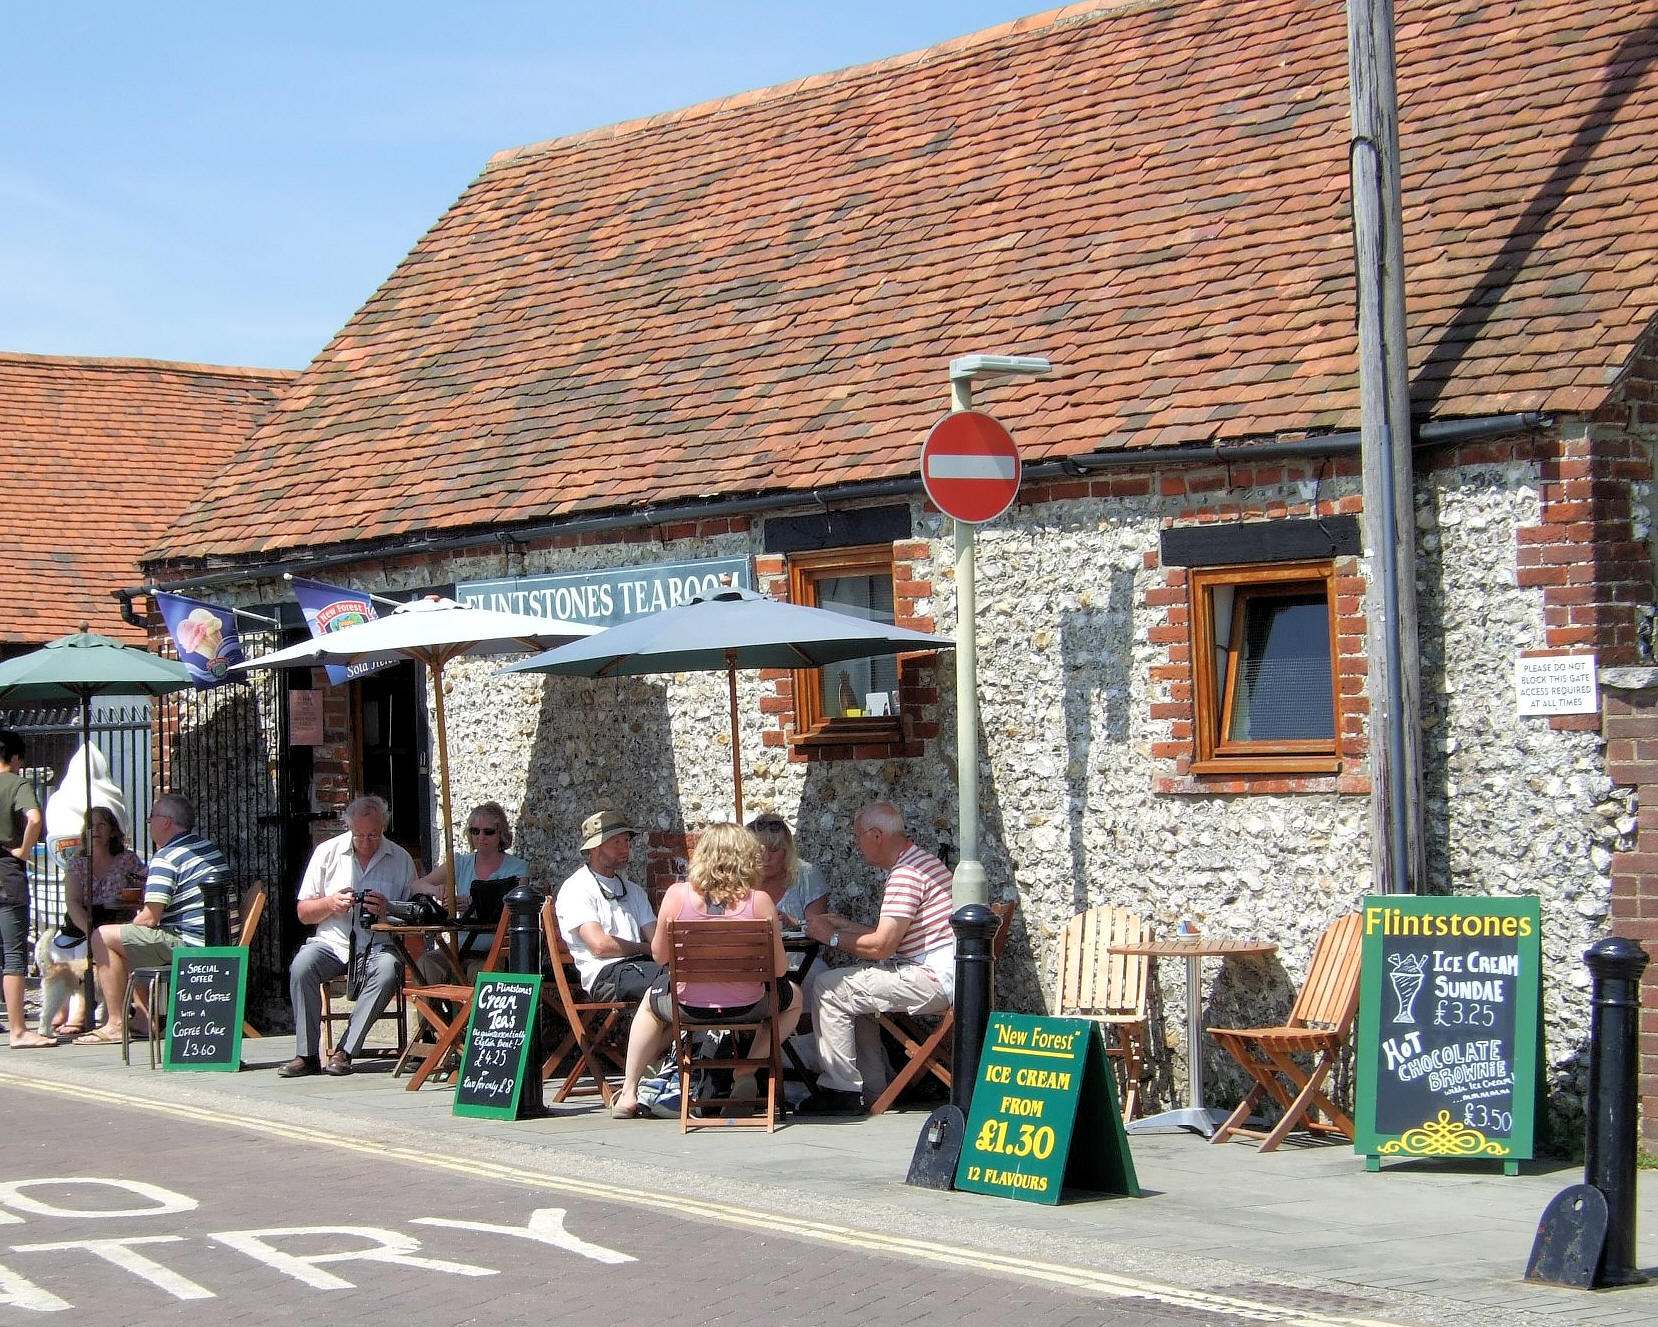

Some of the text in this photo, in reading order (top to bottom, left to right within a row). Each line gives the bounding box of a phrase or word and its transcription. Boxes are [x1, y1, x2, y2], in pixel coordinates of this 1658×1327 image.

[1523, 662, 1586, 673] PLEASE DO NOT
[1521, 674, 1590, 684] BLOCK THIS GATE
[1520, 686, 1592, 696] ACCESS REQUIRED
[1542, 699, 1557, 707] ALL
[1559, 698, 1583, 707] TIMES
[1365, 907, 1533, 937] Flintstones
[187, 963, 220, 974] SPECIAL
[1432, 950, 1519, 977] ICE CREAM
[190, 975, 214, 983] OFFER
[496, 982, 533, 996] Flintstones
[1434, 975, 1505, 1003] SUNDAE
[177, 988, 193, 1002] TEA
[204, 988, 233, 1003] COFFEE
[478, 984, 518, 1010] Cream
[200, 1009, 206, 1017] A
[487, 1008, 517, 1030] Tea's
[1433, 1000, 1495, 1027] £3.25
[172, 1021, 226, 1037] COFFEE CAKE
[474, 1048, 507, 1067] £4.25
[1398, 1039, 1503, 1082] CHOCOLATE
[985, 1064, 1072, 1091] ICE CREAM
[1444, 1086, 1468, 1096] with
[1000, 1096, 1045, 1118] FROM
[1463, 1103, 1513, 1132] £3.50
[975, 1119, 1056, 1160] £1.30
[967, 1166, 1049, 1192] 12 FLAVOURS
